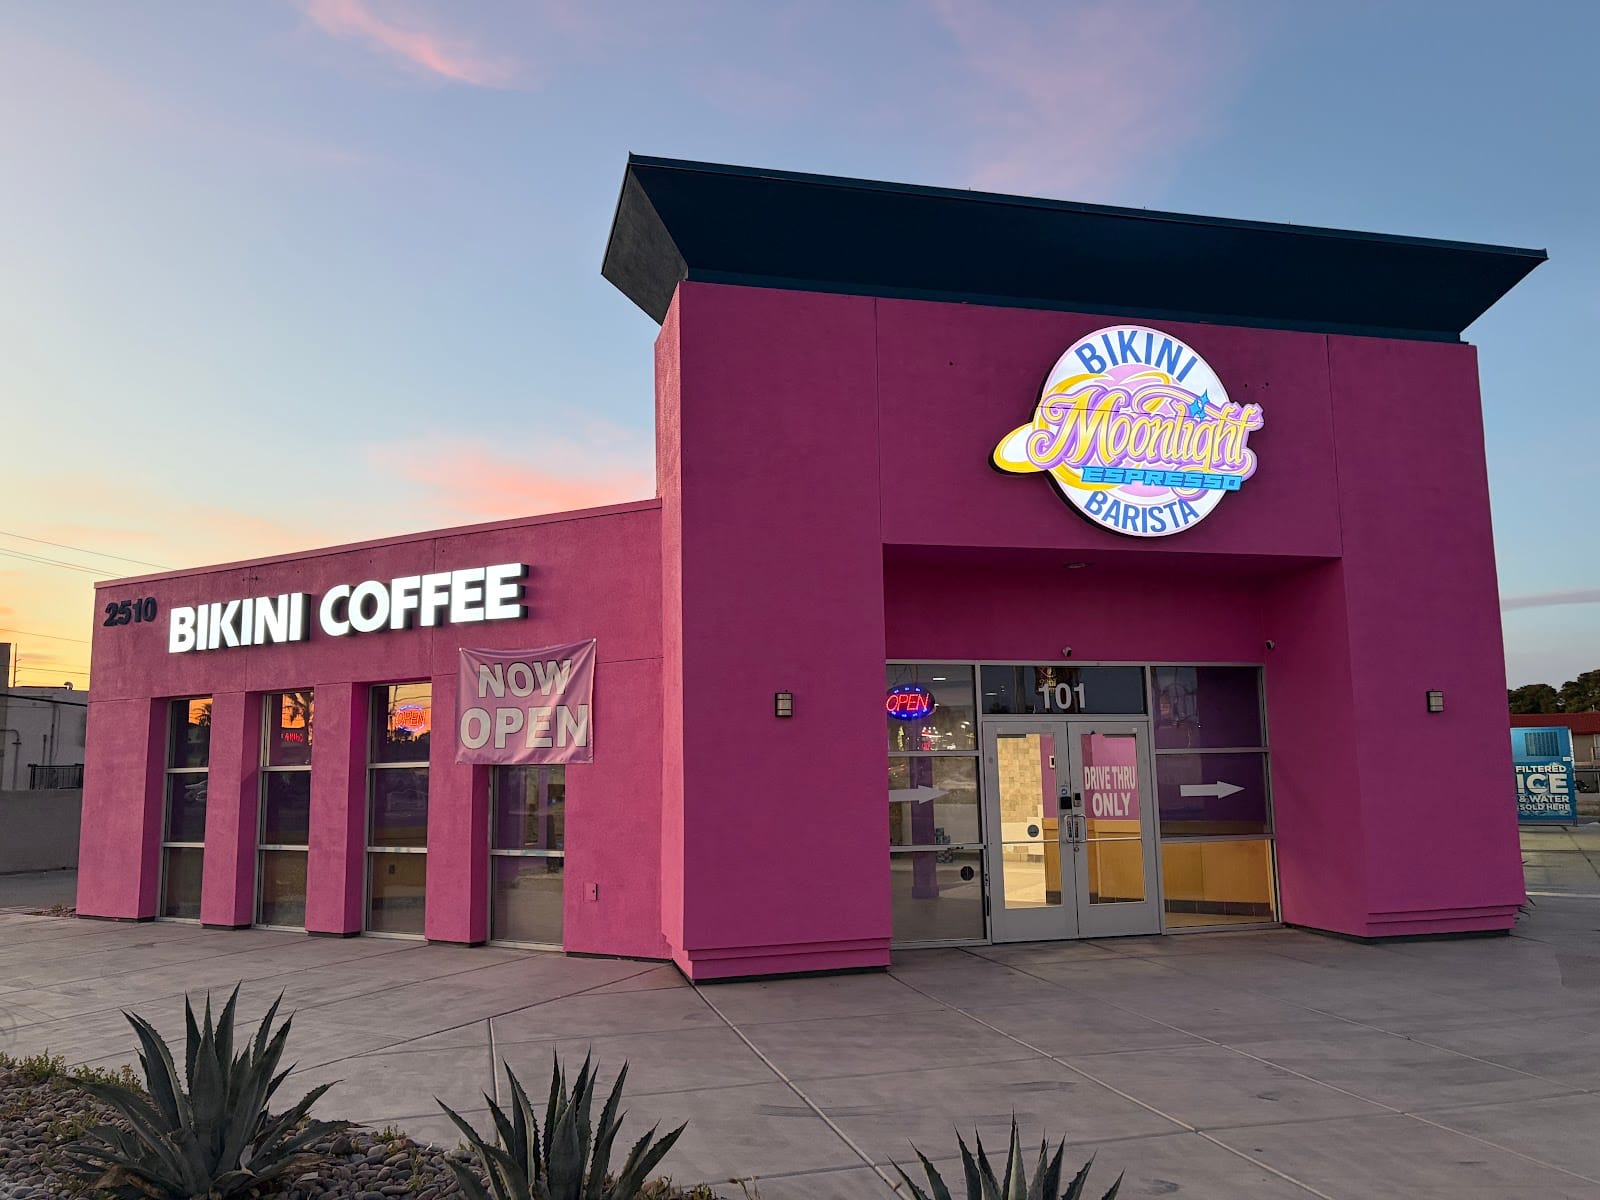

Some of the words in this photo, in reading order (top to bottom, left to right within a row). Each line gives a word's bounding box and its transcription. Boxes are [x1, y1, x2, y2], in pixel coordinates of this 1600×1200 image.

[1075, 329, 1198, 383] BIKINI
[1027, 386, 1263, 482] Moonlight
[1081, 466, 1242, 491] ESPRESSO
[1084, 490, 1199, 533] BARISTA
[104, 597, 157, 627] 2510
[169, 592, 308, 653] BIKINI
[320, 563, 526, 637] COFFEE
[477, 658, 573, 699] NOW
[887, 693, 930, 711] OPEN
[1038, 682, 1086, 710] 101
[396, 710, 426, 726] OPEN
[460, 703, 589, 750] OPEN
[1084, 766, 1111, 790] DRIVE
[1112, 766, 1136, 790] THRU
[1515, 765, 1567, 773] FILTERED
[1516, 773, 1569, 794] ICE
[1092, 792, 1131, 817] ONLY
[1519, 795, 1528, 803] &
[1530, 795, 1569, 803] WATER
[1520, 803, 1545, 811] SOLD
